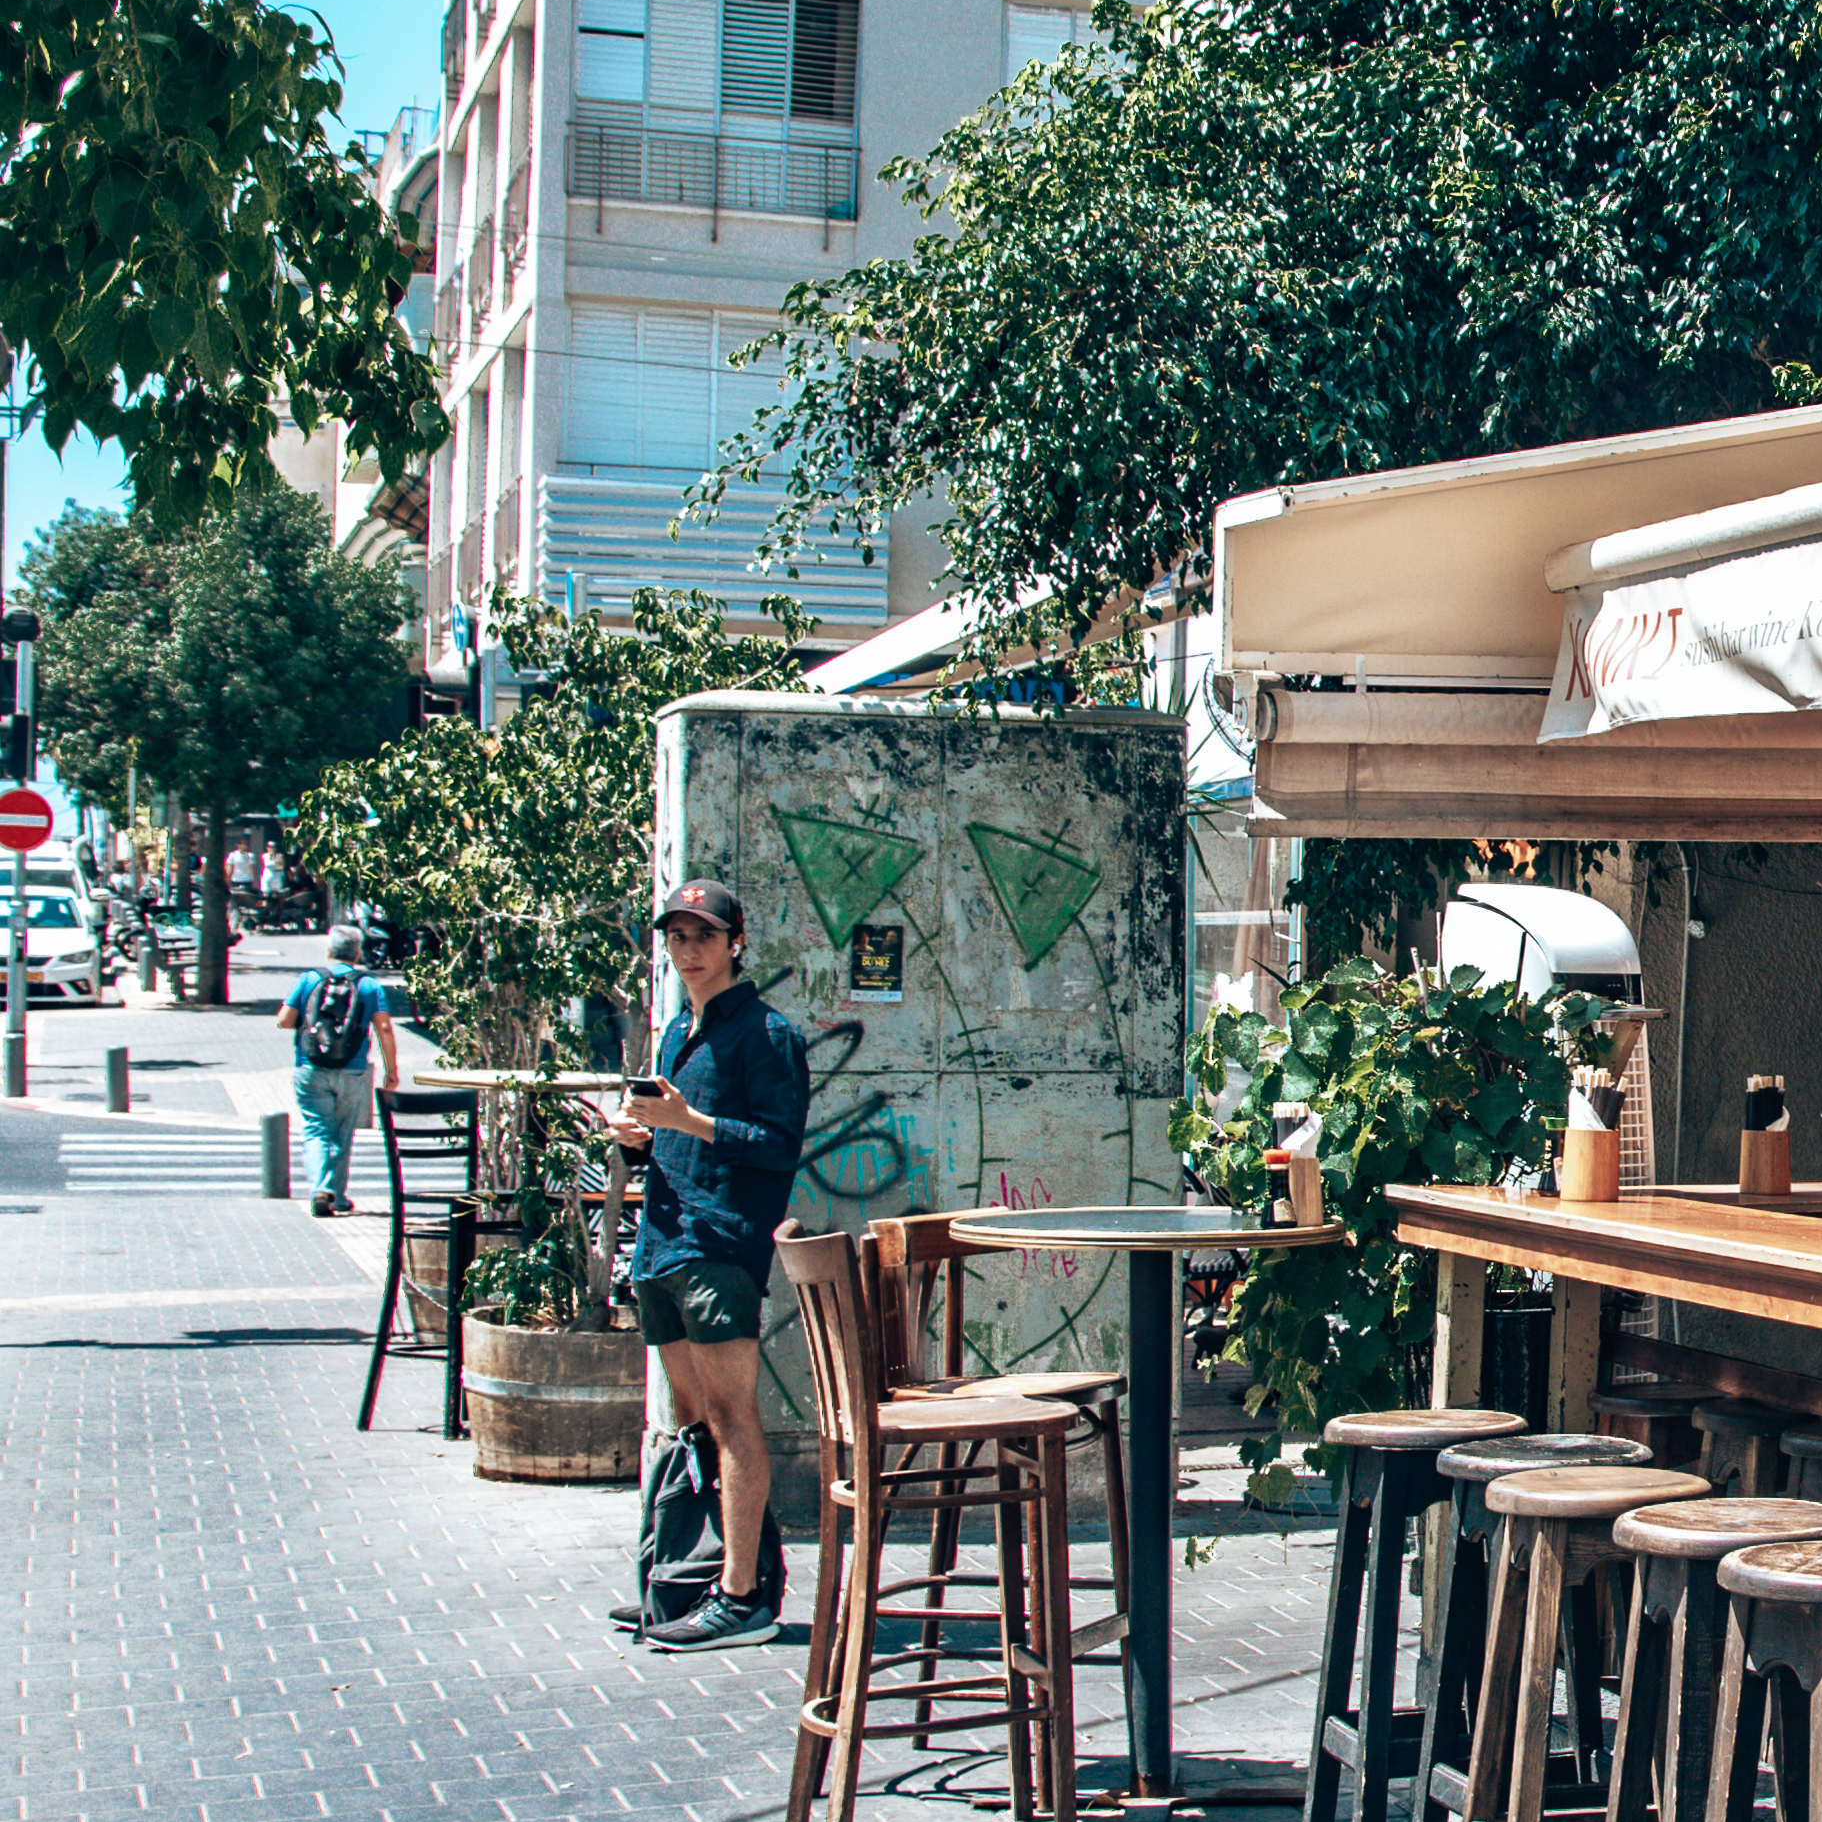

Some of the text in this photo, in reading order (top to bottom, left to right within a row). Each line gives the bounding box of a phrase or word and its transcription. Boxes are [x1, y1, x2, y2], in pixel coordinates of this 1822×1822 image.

[1681, 624, 1723, 667] sushi
[1721, 621, 1746, 659] bar
[1748, 611, 1796, 649] wine
